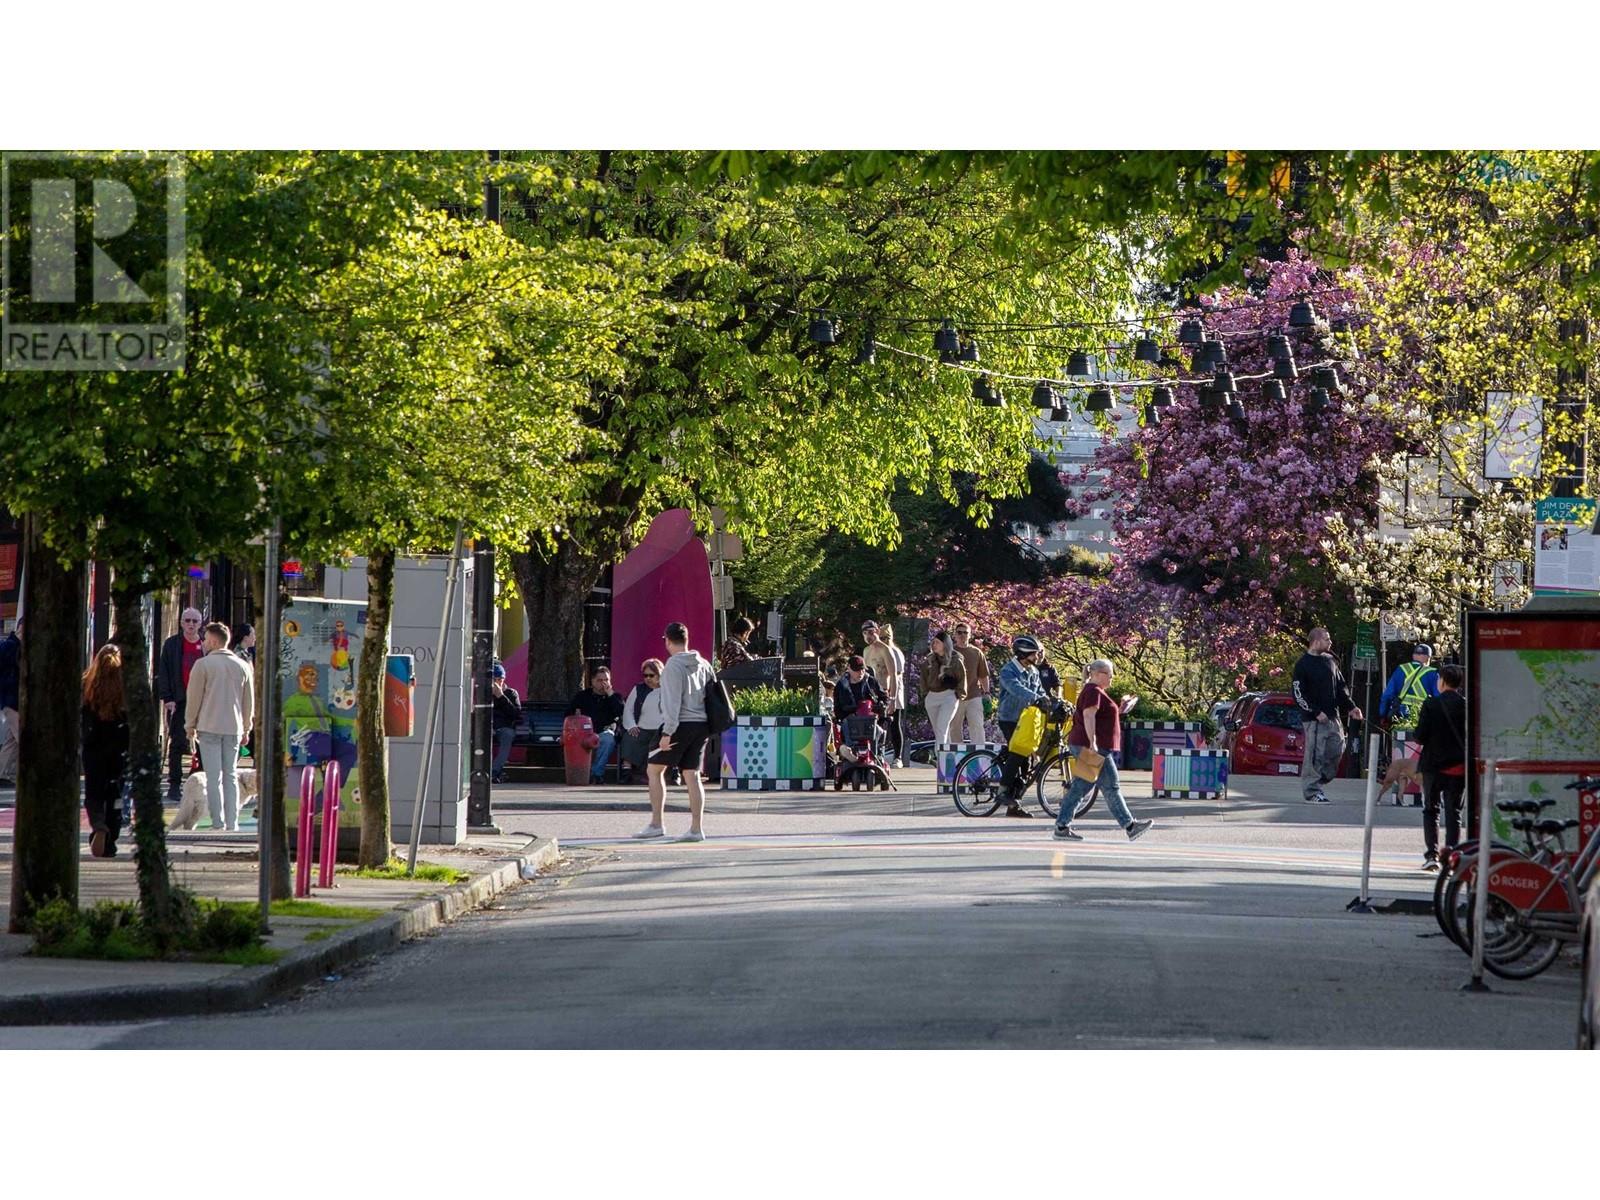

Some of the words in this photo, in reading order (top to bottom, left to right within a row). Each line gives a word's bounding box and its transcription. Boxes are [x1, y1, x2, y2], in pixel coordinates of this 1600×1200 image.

[1542, 502, 1557, 510] JIM
[1541, 510, 1572, 518] PLAZA
[1502, 876, 1540, 889] ROGERS
